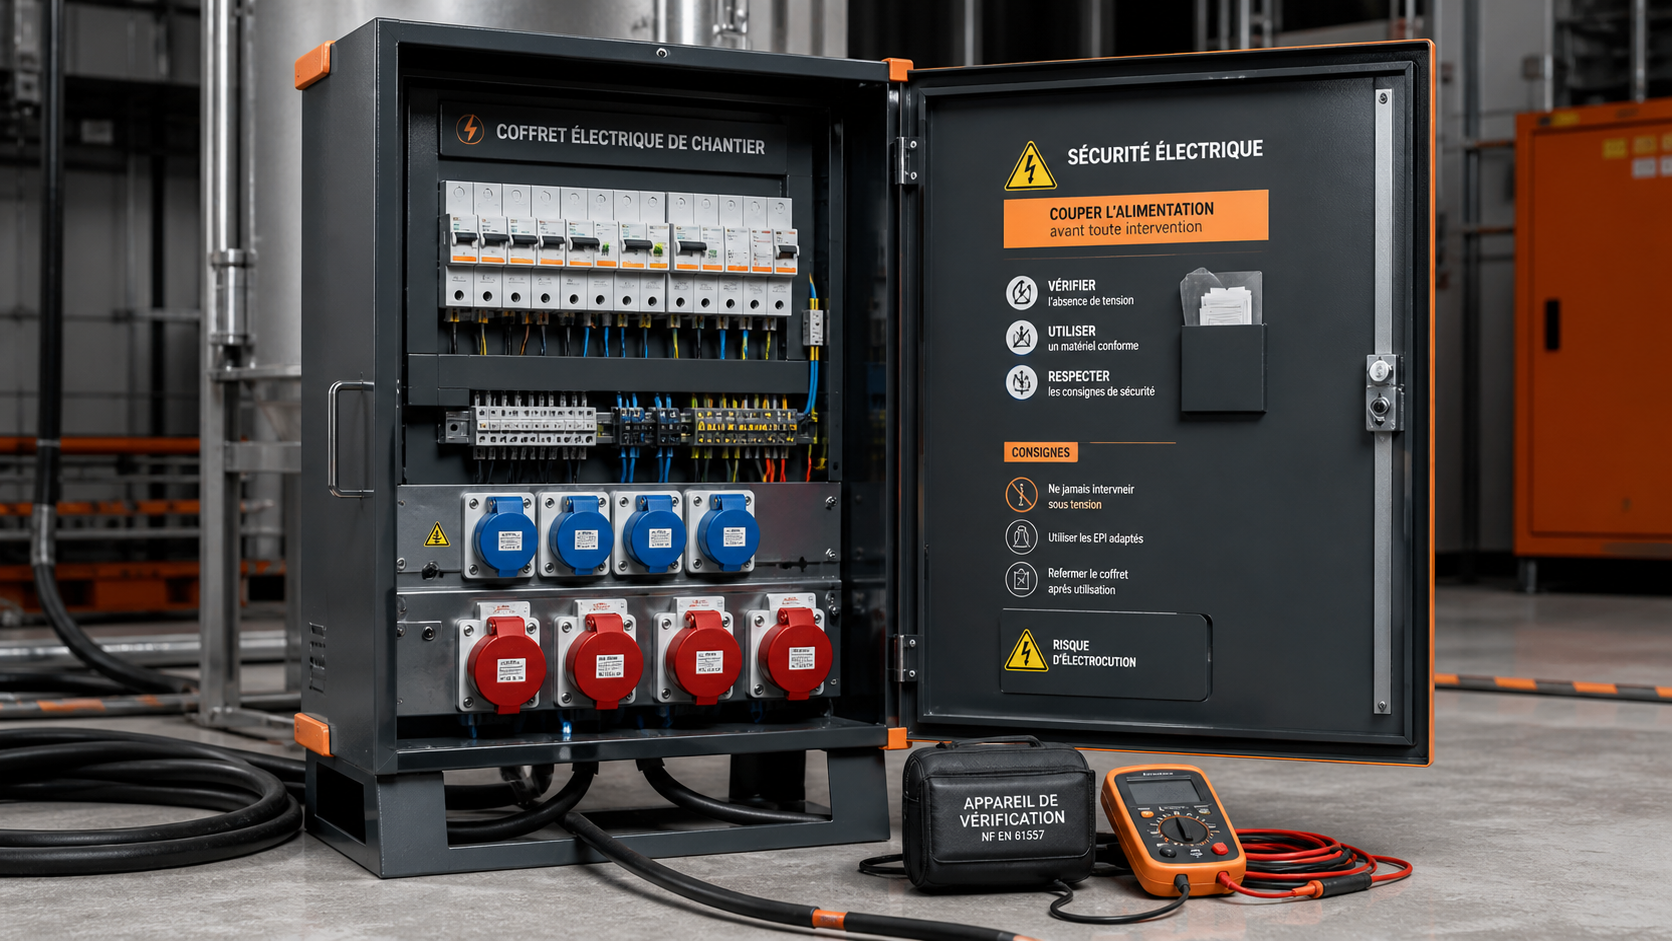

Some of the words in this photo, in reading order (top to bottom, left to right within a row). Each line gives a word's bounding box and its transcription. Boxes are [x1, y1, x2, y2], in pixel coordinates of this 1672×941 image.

[497, 124, 567, 142] COFFRET
[572, 125, 663, 149] ÉLECTRIQUE
[668, 134, 687, 149] DE
[692, 136, 765, 154] CHANTIER
[1067, 142, 1150, 166] SÉCURITÉ
[1156, 140, 1263, 161] ÉLECTRIQUE
[1050, 206, 1102, 220] COUPER
[1106, 202, 1213, 218] L'ALIMENTATION
[1050, 225, 1084, 237] avant
[1088, 224, 1121, 236] toute
[1126, 220, 1202, 234] intervention
[1048, 278, 1095, 291] VÉRIFIER
[1049, 297, 1087, 306] l'absence
[1090, 296, 1100, 305] de
[1102, 295, 1134, 305] tension
[1049, 325, 1095, 337] UTILISER
[1061, 341, 1095, 351] matériel
[1098, 340, 1139, 350] conforme
[1049, 370, 1109, 382] RESPECTER
[1048, 386, 1060, 397] les
[1062, 386, 1105, 399] consignes
[1107, 386, 1118, 396] de
[1120, 386, 1155, 396] sécurité
[1012, 447, 1070, 457] CONSIGNES
[1049, 484, 1060, 493] Ne
[1062, 484, 1090, 496] jamais
[1049, 501, 1068, 509] sous
[1070, 499, 1101, 509] tension
[1049, 532, 1077, 542] Utiliser
[1080, 533, 1091, 542] les
[1094, 533, 1107, 543] EPI
[1109, 533, 1143, 546] adaptés
[1049, 568, 1088, 578] Refermer
[1090, 569, 1097, 578] le
[1100, 569, 1128, 579] coffret
[1074, 584, 1115, 594] utilisation
[1053, 639, 1090, 652] RISQUE
[964, 794, 1036, 810] APPAREIL
[1039, 794, 1058, 807] DE
[959, 810, 1066, 828] VÉRIFICATION
[982, 832, 995, 841] NF
[998, 831, 1011, 841] EN
[1015, 830, 1044, 840] 61557
